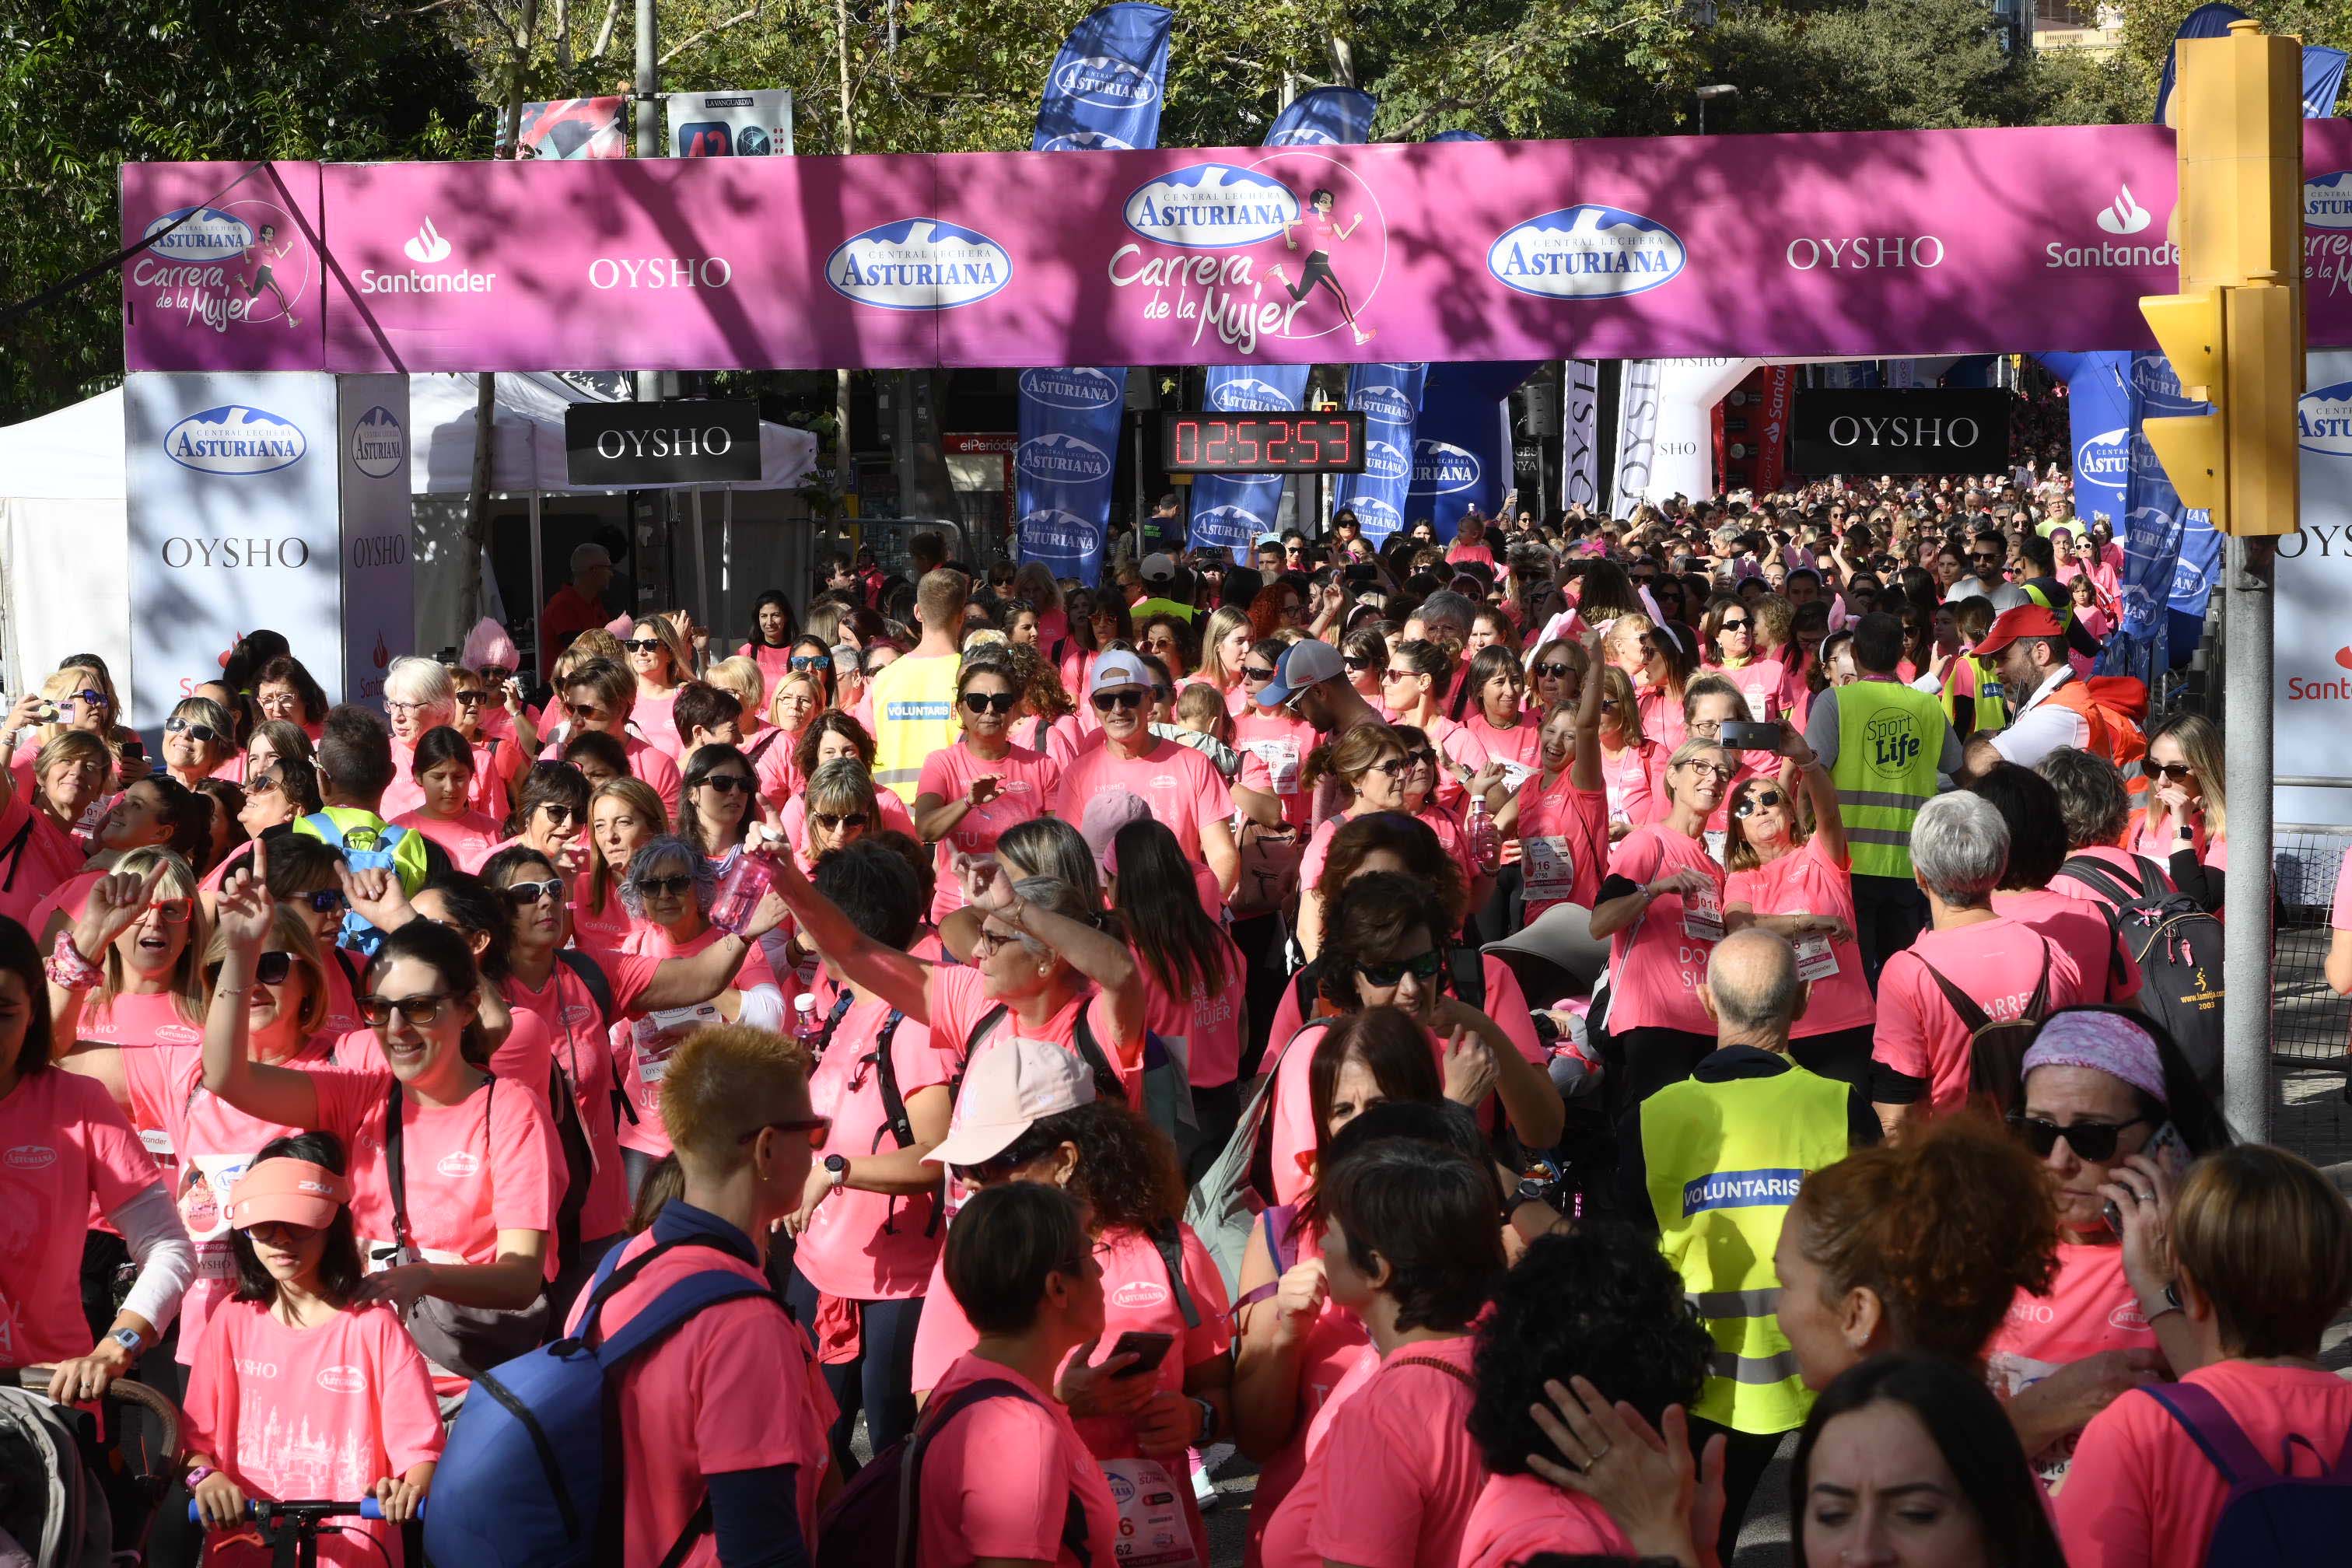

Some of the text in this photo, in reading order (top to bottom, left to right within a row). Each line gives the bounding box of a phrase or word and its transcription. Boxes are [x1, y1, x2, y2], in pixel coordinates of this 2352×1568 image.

[1062, 68, 1149, 100] ASTURIANA
[1164, 191, 1282, 201] CENTRAL LECHERA
[1136, 195, 1286, 226] ASTURIANA
[869, 250, 926, 259] CENTRAL
[1534, 236, 1664, 248] CENTRAL LECHERA
[1787, 236, 1944, 270] OYSHO
[2046, 241, 2179, 268] Santande
[840, 253, 997, 286] ASTURIANA
[1108, 243, 1253, 287] Carrera
[1503, 242, 1670, 276] ASTURIANA
[2319, 257, 2333, 278] la
[134, 258, 226, 288] Carrera
[361, 269, 495, 293] Santander
[589, 257, 731, 289] OYSHO
[156, 283, 259, 333] de la Mujer
[1144, 282, 1307, 355] de la Mujer
[1027, 373, 1110, 401] ASTURIANA
[1769, 365, 1787, 420] Santa
[1355, 397, 1412, 420] ASTURIANA
[1570, 360, 1597, 506] OYSH
[1620, 359, 1658, 499] OYSH
[1829, 416, 1979, 447] OYSHO
[175, 431, 296, 457] ASTURIANA
[356, 441, 401, 460] ASTURIANA
[597, 426, 732, 459] OYSHO
[961, 439, 1018, 451] elPeriódic
[1177, 422, 1349, 464] 02:52:53
[1024, 448, 1103, 474] ASTURIANA
[1367, 459, 1402, 474] URIANA
[1412, 467, 1473, 481] URIANA
[1020, 525, 1094, 551] ASTURIANA
[1198, 518, 1255, 541] ASTURIAN
[163, 537, 309, 569] OYSHO
[354, 534, 404, 568] OYSHO
[888, 706, 949, 716] VOLUNTARIS
[1867, 716, 1913, 741] Sport
[1876, 733, 1920, 767] Life
[956, 832, 979, 847] TU
[1700, 898, 1720, 911] 016
[1806, 964, 1832, 975] Santander
[1195, 996, 1209, 1013] DE
[2199, 1002, 2215, 1010] 2003
[1195, 1006, 1232, 1029] MUJER
[159, 1029, 196, 1040] ASTURIANA
[139, 1135, 167, 1146] ntander
[8, 1153, 52, 1164] ASTURIANA
[299, 1181, 334, 1195] 2XU
[1684, 1178, 1801, 1207] VOLUNTARIS
[198, 1260, 231, 1270] YSHO
[1118, 1292, 1164, 1303] ASTURIANA
[234, 1359, 278, 1379] YSHO
